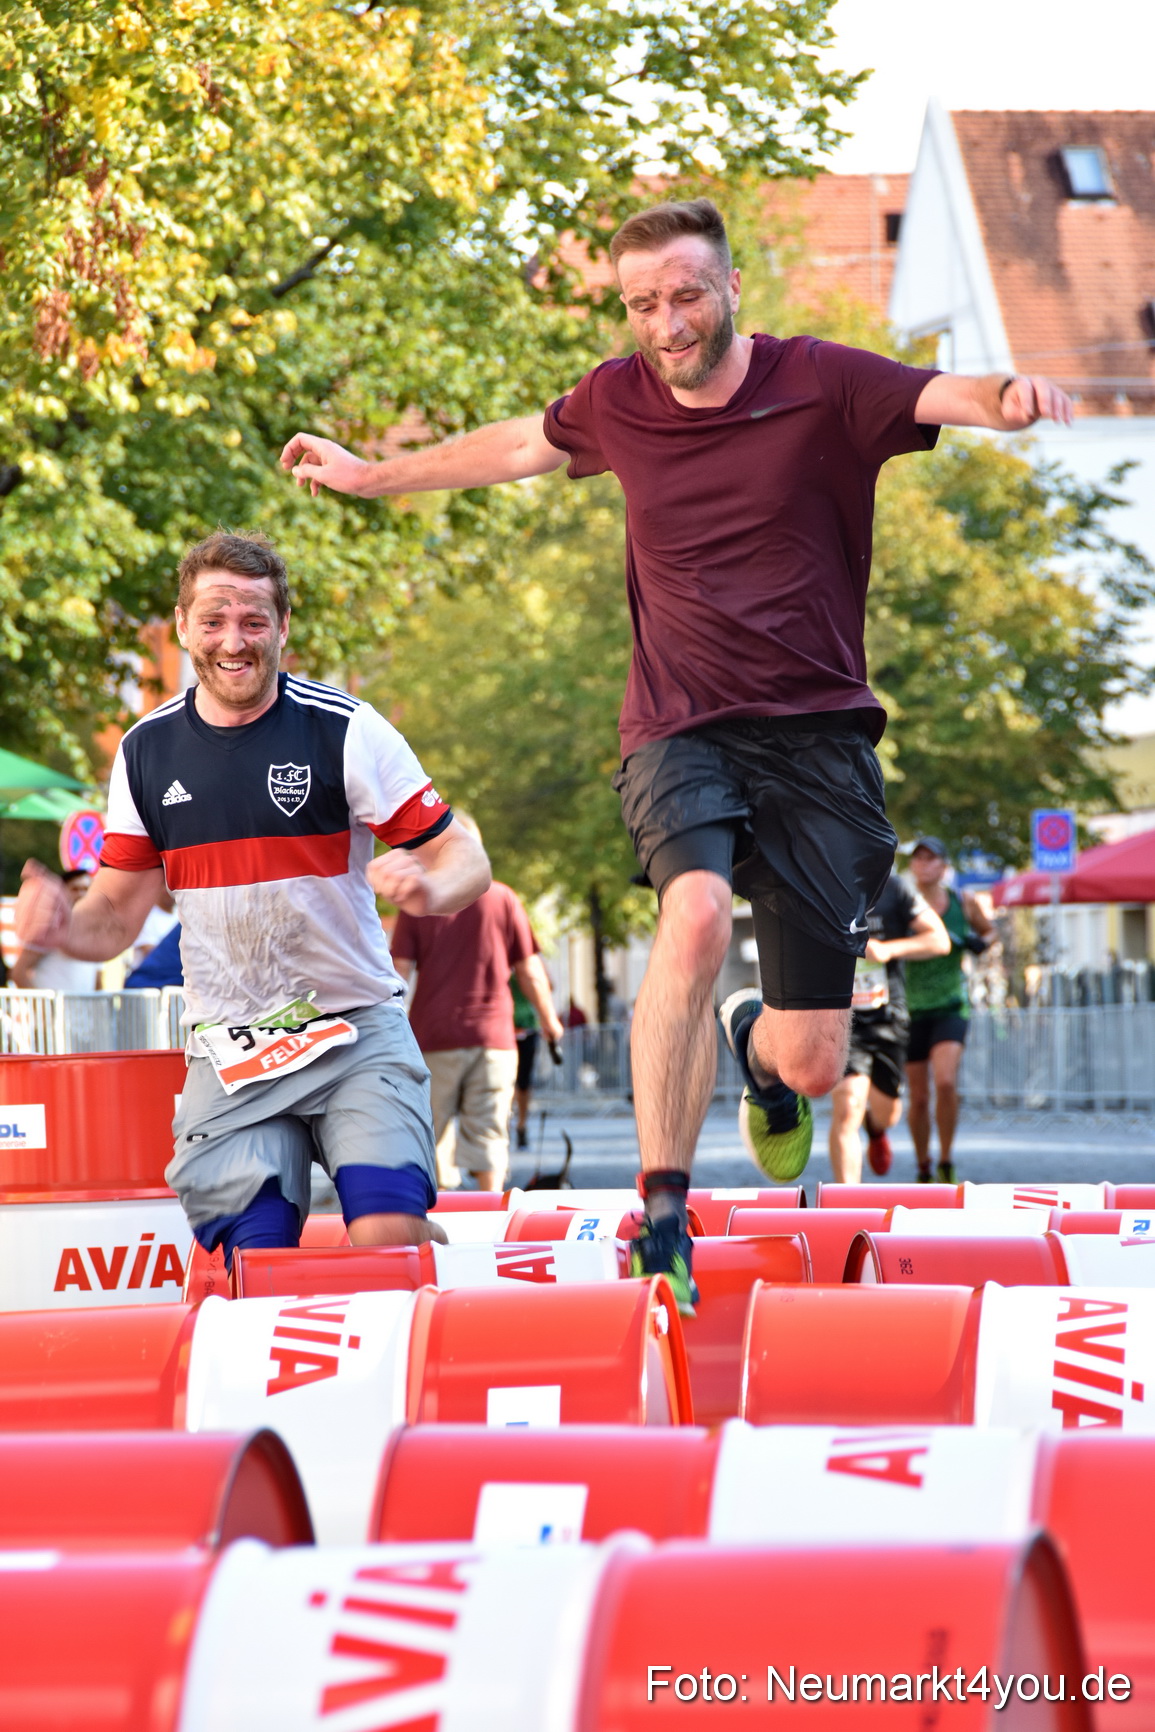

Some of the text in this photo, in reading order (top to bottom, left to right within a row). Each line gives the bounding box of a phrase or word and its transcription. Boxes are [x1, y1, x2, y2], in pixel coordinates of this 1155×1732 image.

[273, 786, 305, 796] Blackout
[162, 793, 193, 806] adidas
[260, 1033, 315, 1070] FELIX
[899, 1257, 914, 1275] 362
